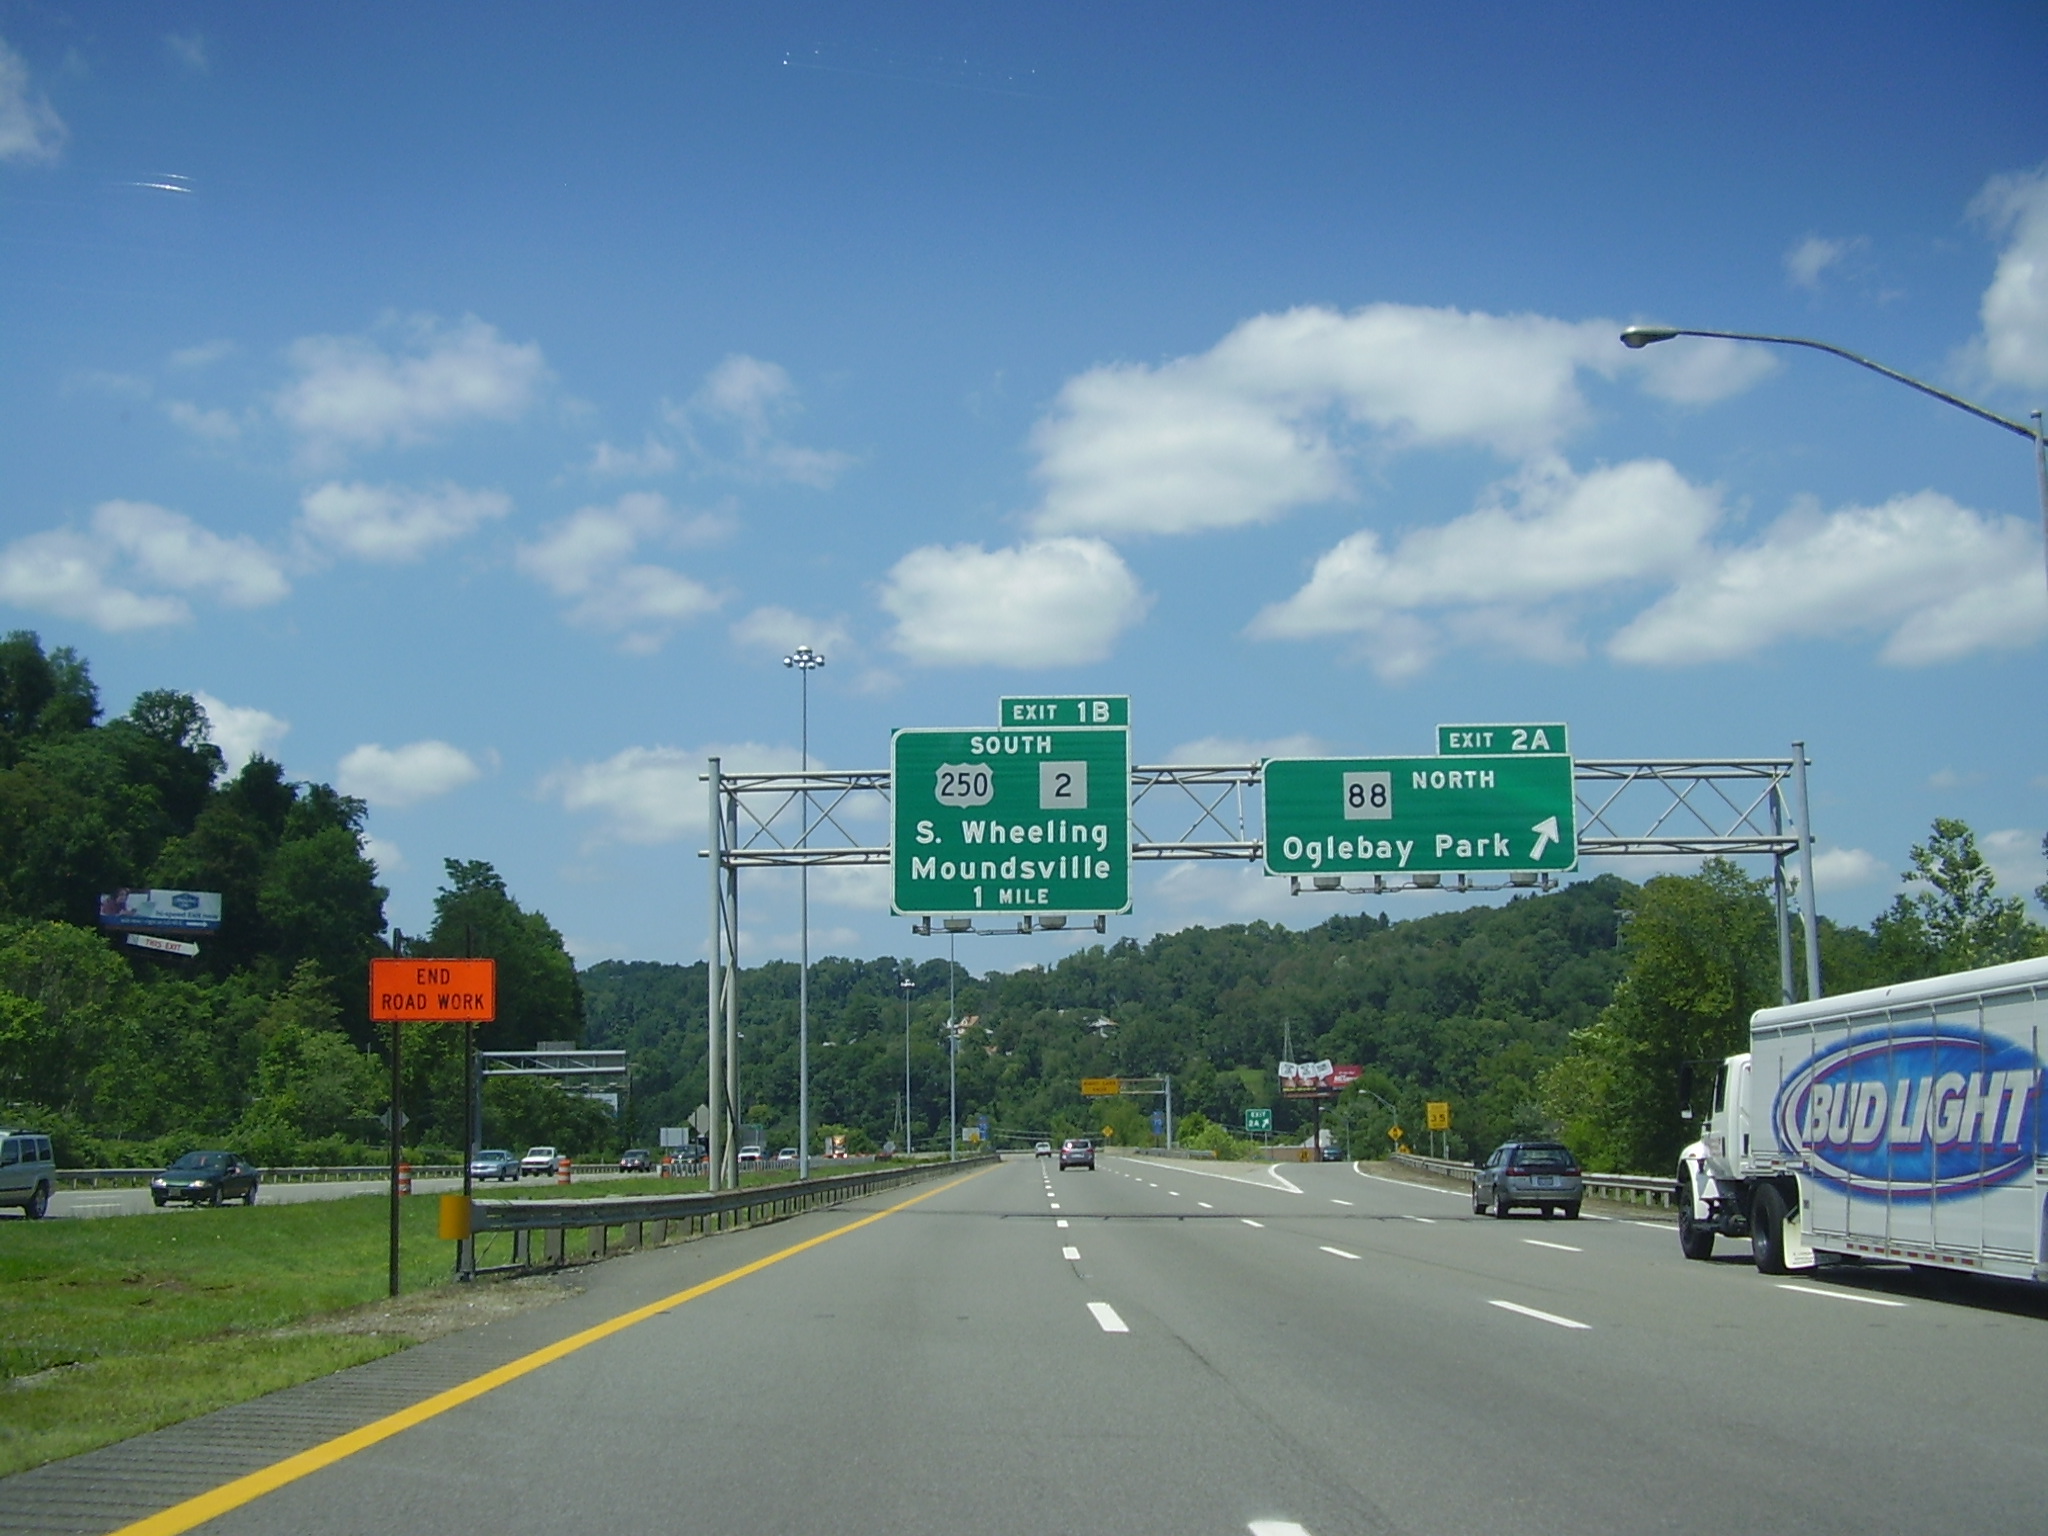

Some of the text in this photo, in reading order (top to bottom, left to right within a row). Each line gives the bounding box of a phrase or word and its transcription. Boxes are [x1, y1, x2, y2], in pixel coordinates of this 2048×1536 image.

[1013, 701, 1110, 723] EXIT 1B
[970, 736, 1052, 754] SOUTH
[1449, 729, 1550, 750] EXIT 2A
[940, 772, 989, 797] 250
[1054, 773, 1072, 797] 2
[1412, 770, 1495, 789] NORTH
[1348, 783, 1387, 808] 88
[915, 819, 1108, 852] S. Wheeling
[1283, 832, 1510, 869] Oglebay Park
[911, 855, 1111, 880] Moundsville
[973, 886, 1049, 908] 1 MILE
[165, 942, 183, 951] EXIT
[417, 968, 451, 985] END
[382, 993, 485, 1010] ROAD WORK
[1250, 1110, 1266, 1118] EXIT
[1431, 1114, 1446, 1122] 35
[1802, 1069, 2041, 1148] BUD LIGHT
[1248, 1119, 1260, 1128] 2A
